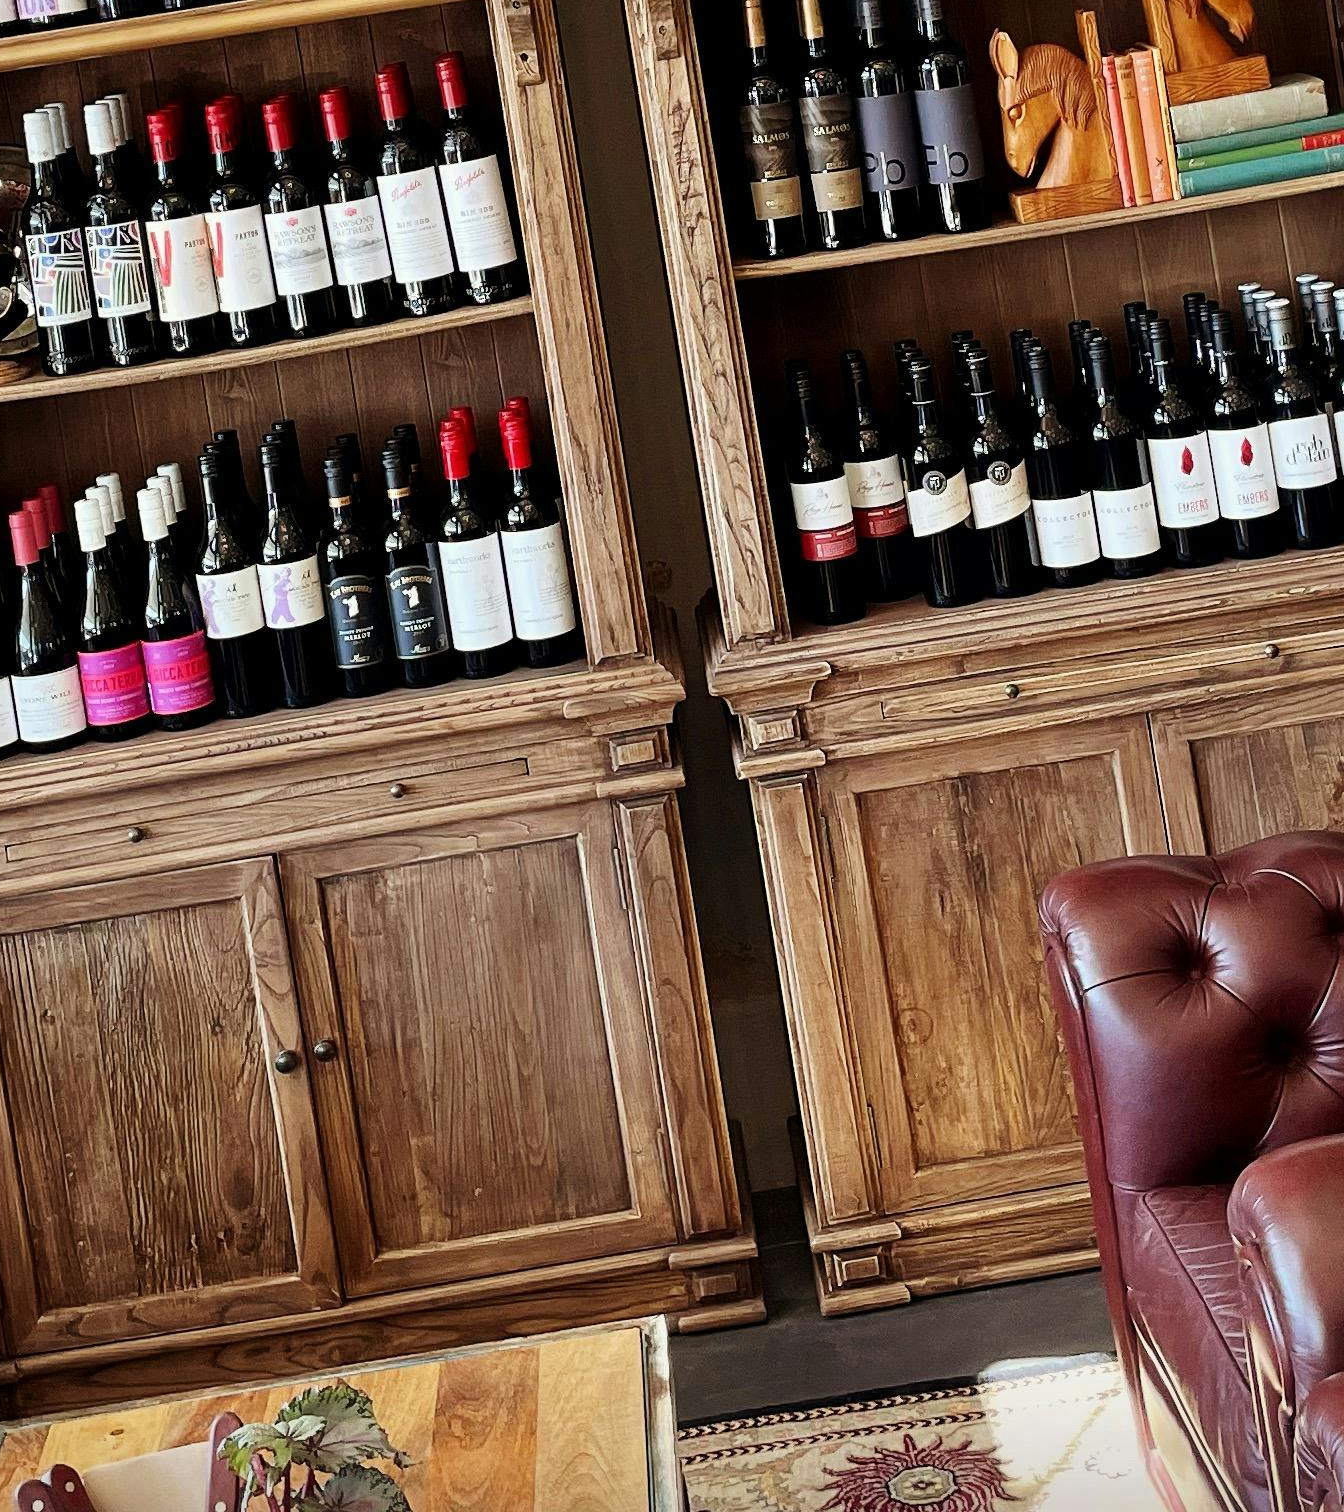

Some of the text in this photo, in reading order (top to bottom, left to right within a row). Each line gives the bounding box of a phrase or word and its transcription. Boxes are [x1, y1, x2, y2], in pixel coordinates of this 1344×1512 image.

[752, 131, 790, 144] SALMOS
[813, 123, 850, 137] SALMOS
[454, 168, 485, 192] Penfolds
[391, 180, 423, 203] Penfolds
[1238, 490, 1269, 505] EMBERS
[1178, 499, 1209, 514] EMBERS
